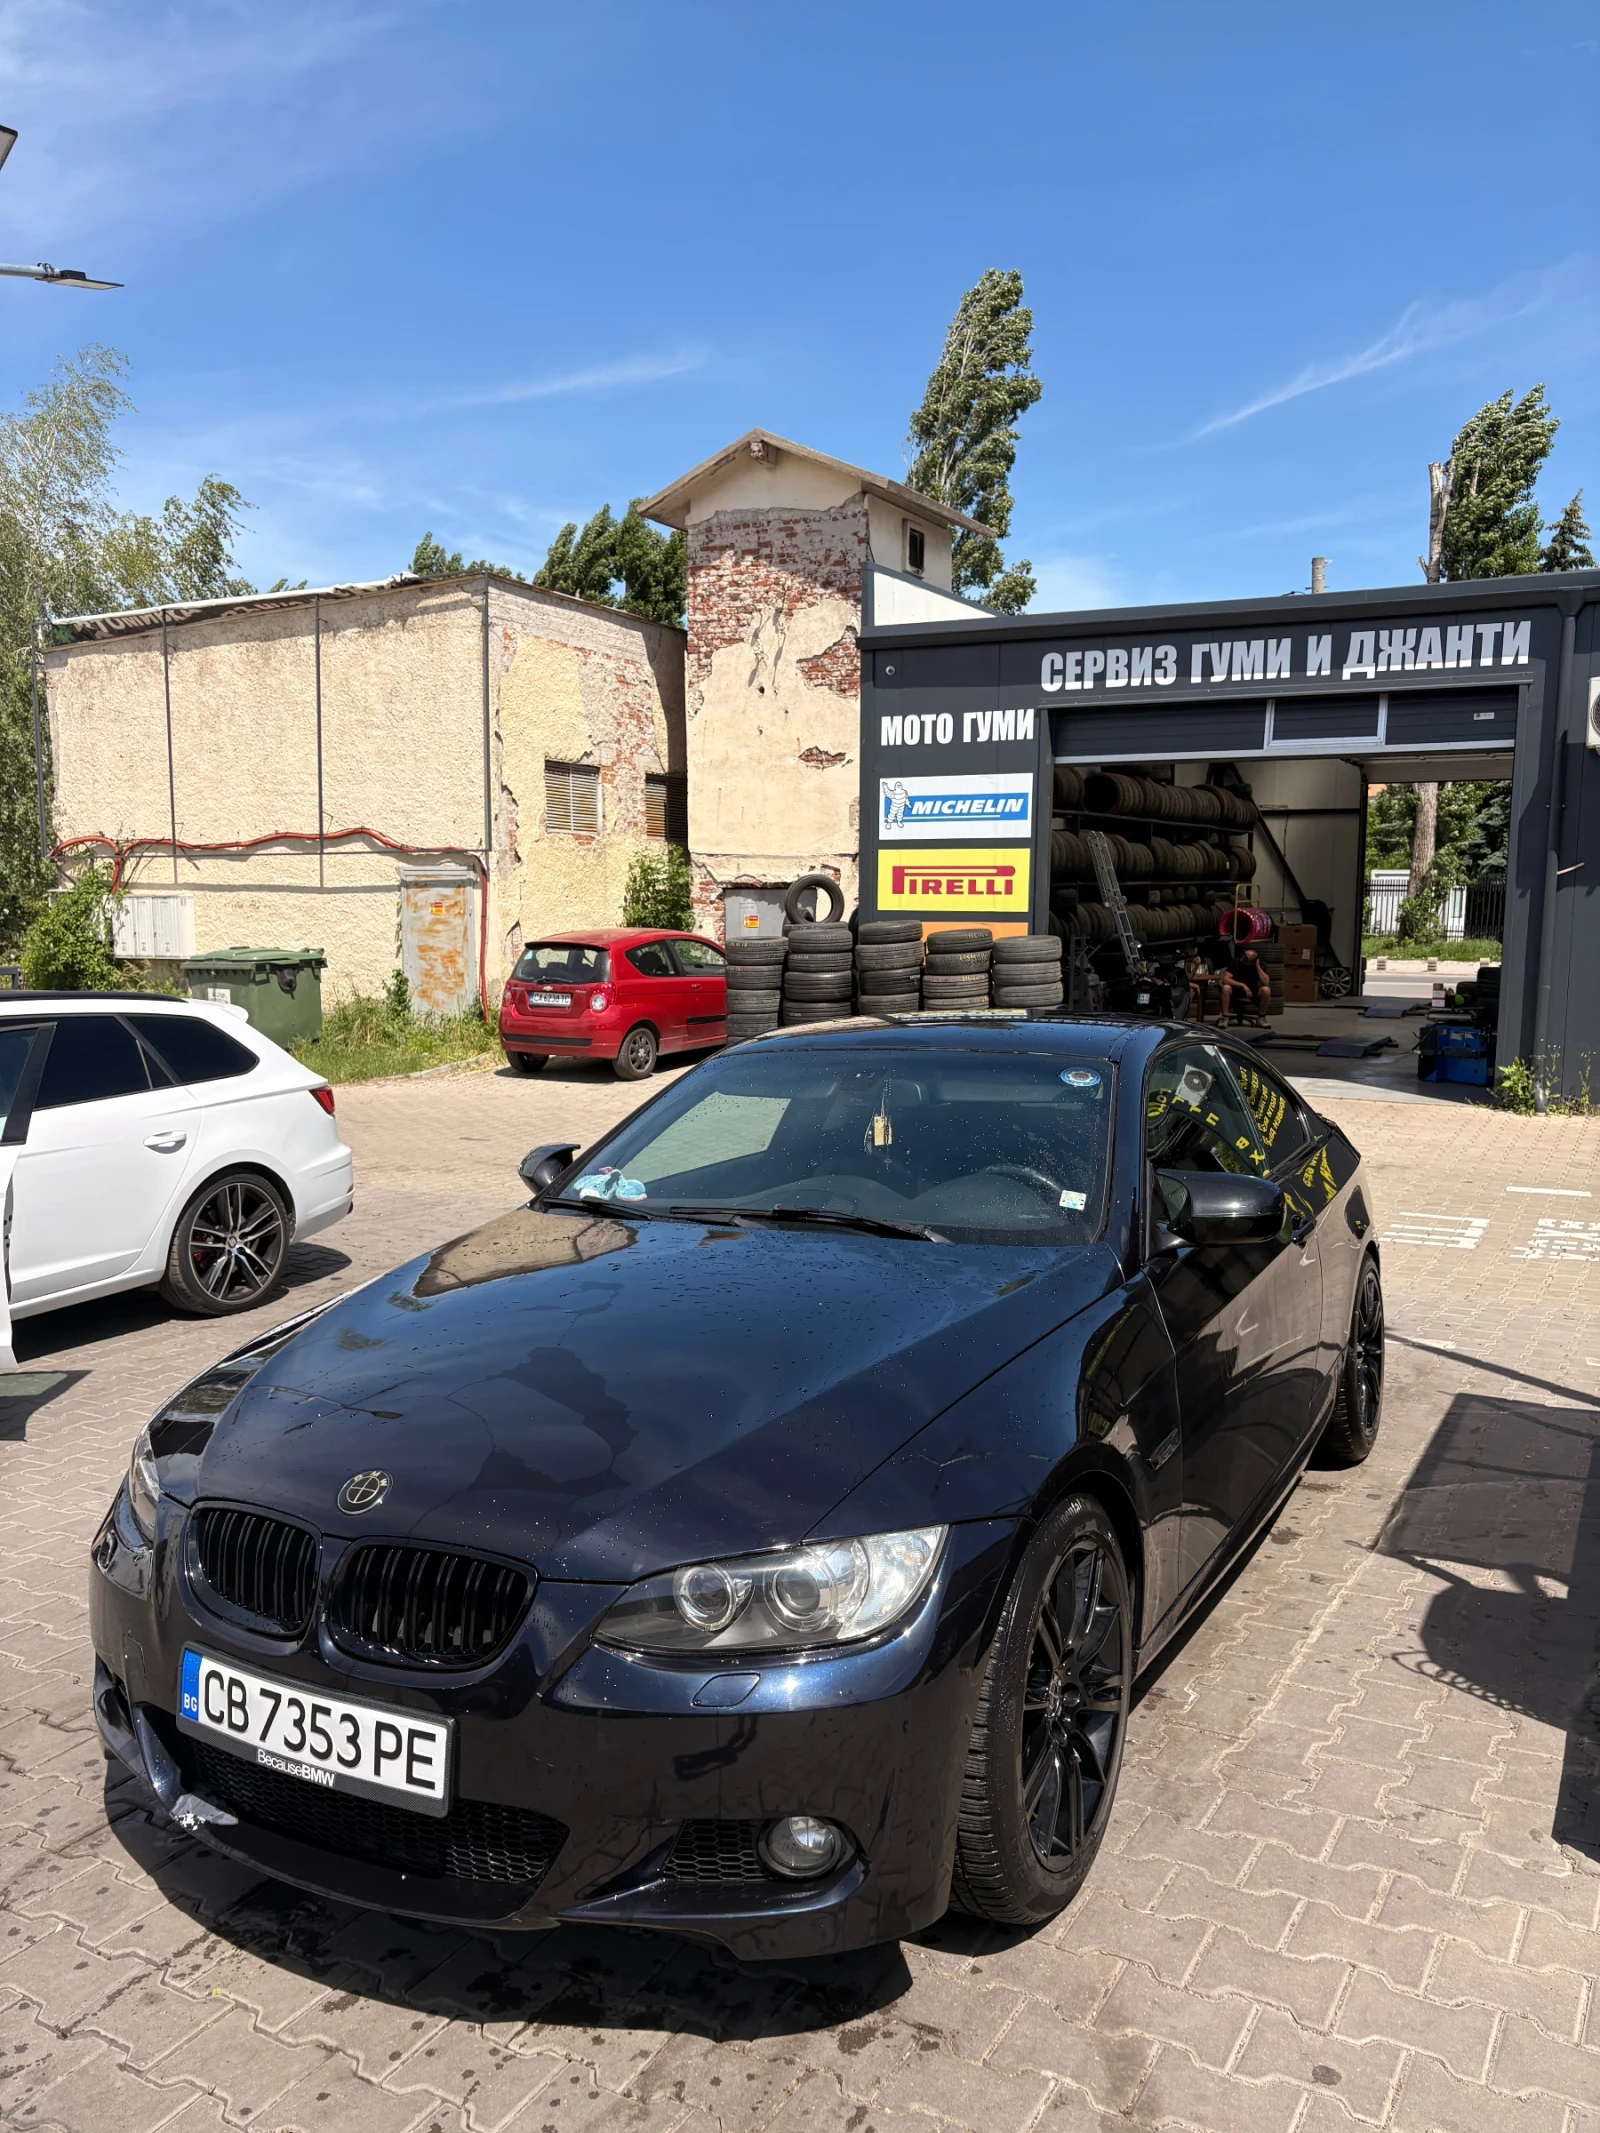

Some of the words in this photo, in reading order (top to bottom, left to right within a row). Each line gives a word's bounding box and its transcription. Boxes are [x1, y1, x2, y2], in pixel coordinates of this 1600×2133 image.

[1040, 644, 1178, 692] СЕРВИЗ
[1191, 638, 1292, 684] ГУМИ
[1306, 635, 1332, 677] И
[1342, 621, 1531, 680] ДЖАНТИ
[881, 713, 954, 746] МОТО
[963, 708, 1034, 743] ГУМИ
[911, 799, 1024, 815] MICHELIN
[892, 866, 1016, 895] PIRELLI
[353, 1470, 388, 1487] BMW
[183, 1693, 197, 1712] BG
[204, 1669, 249, 1733] CB
[259, 1687, 362, 1768] 7353
[373, 1720, 436, 1790] PE
[257, 1749, 335, 1787] BecauseBMW
